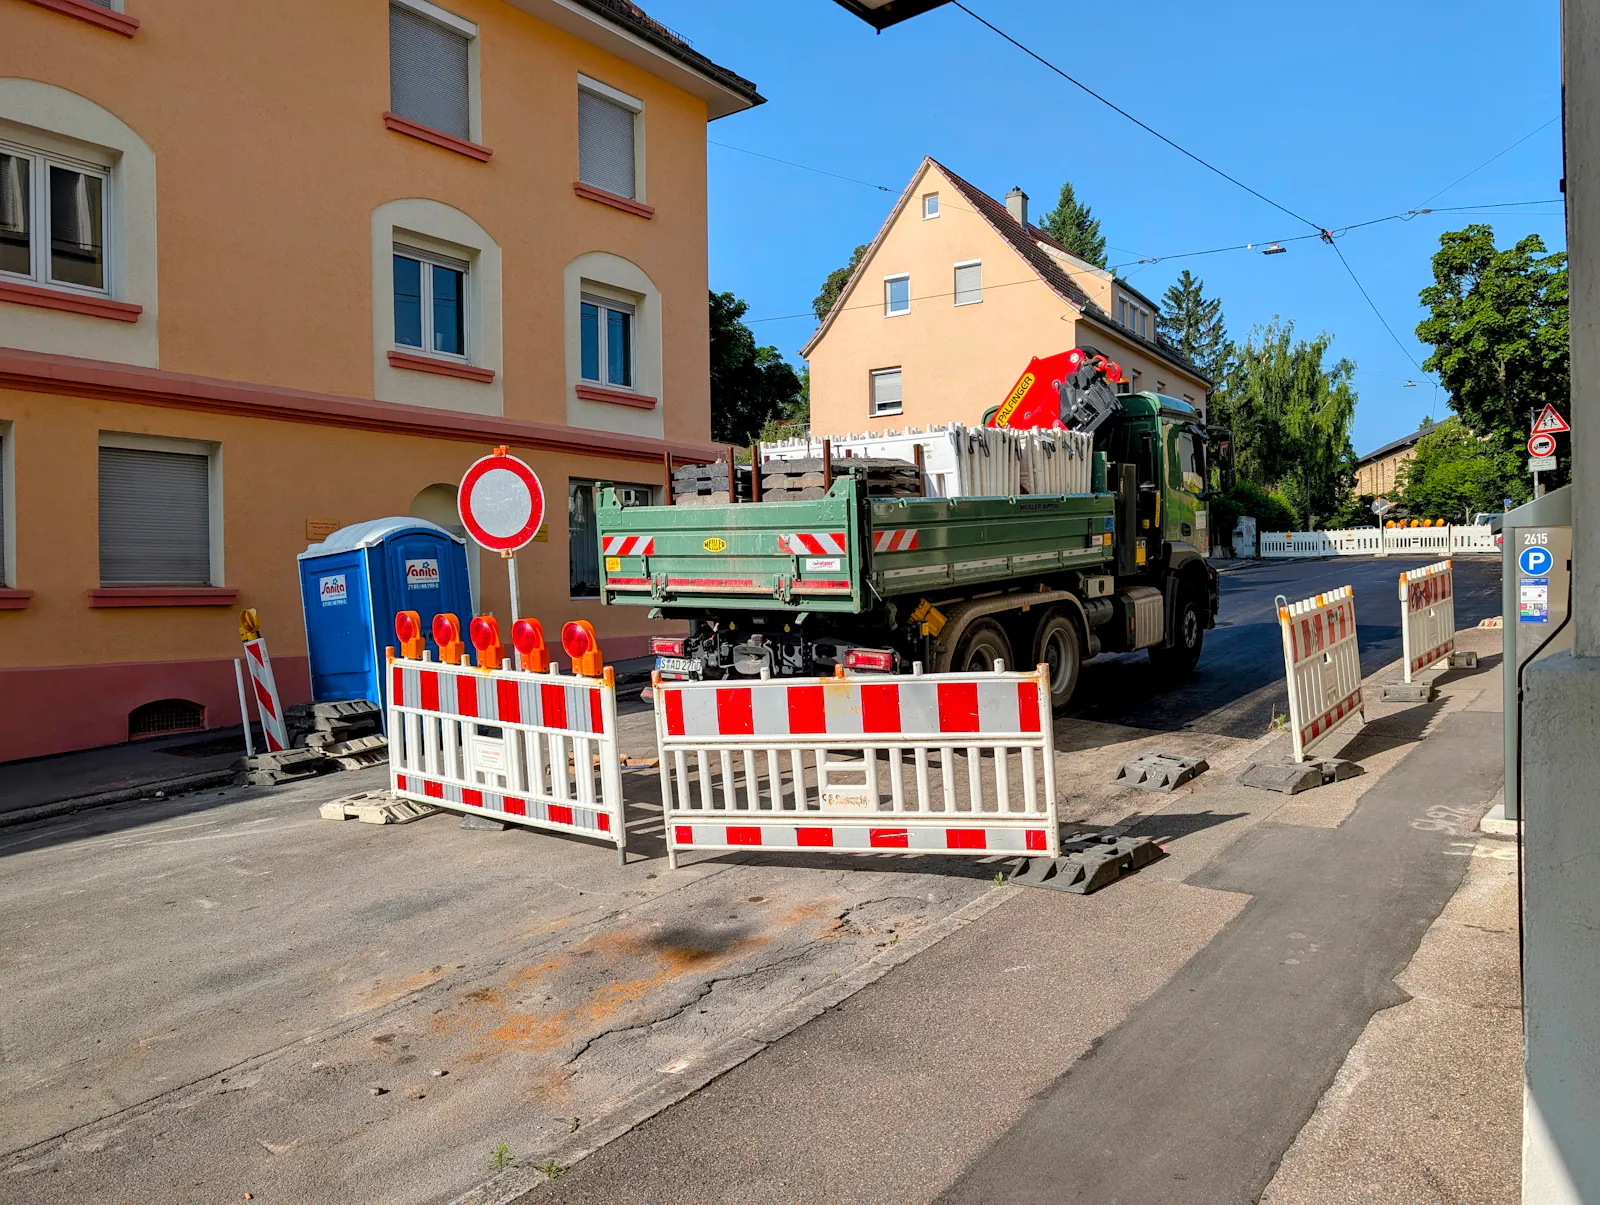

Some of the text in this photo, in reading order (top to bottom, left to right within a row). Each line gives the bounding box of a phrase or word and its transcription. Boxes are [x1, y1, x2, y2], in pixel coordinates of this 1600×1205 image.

[998, 376, 1033, 424] PALFINGER
[704, 538, 726, 551] MEILLER
[1524, 533, 1548, 545] 2615
[1528, 552, 1546, 570] P
[406, 564, 438, 577] Sanita
[321, 581, 345, 595] Sanita
[660, 658, 666, 669] S
[670, 659, 681, 670] AD
